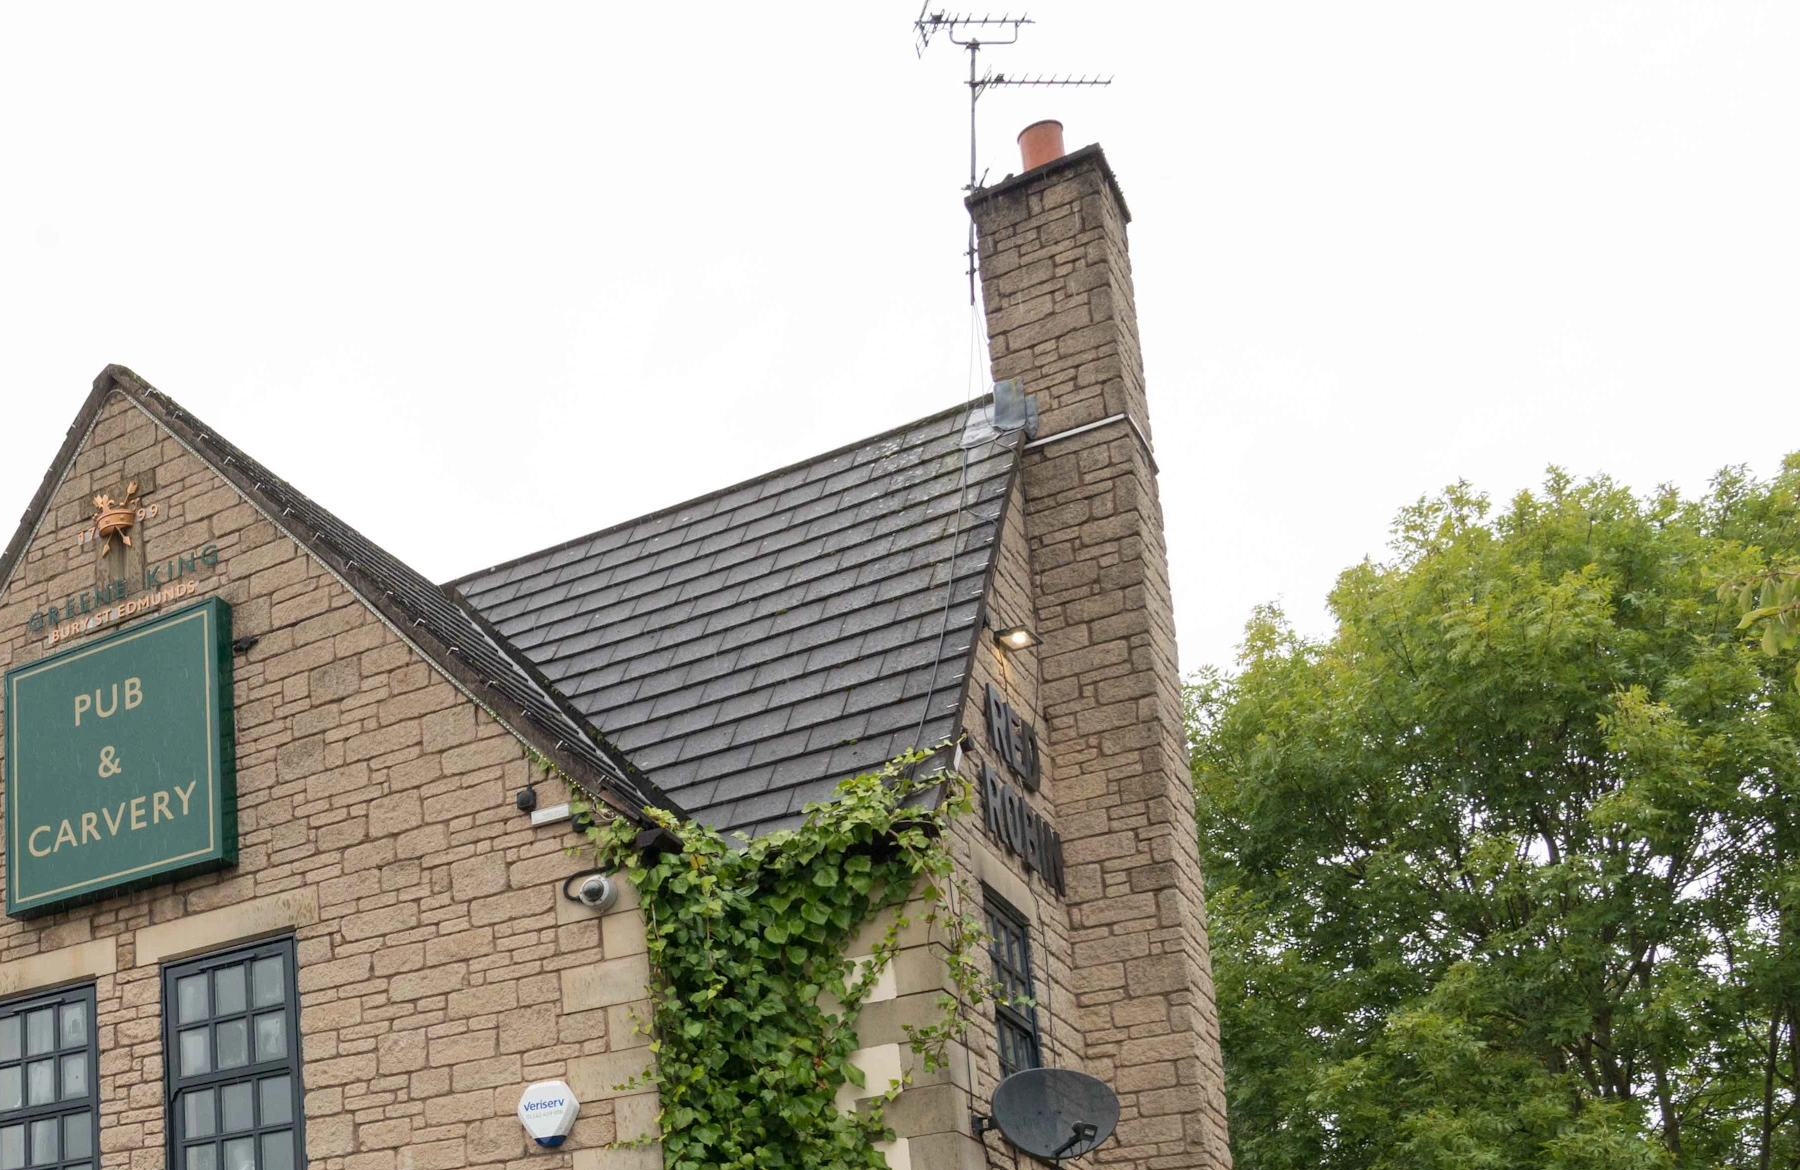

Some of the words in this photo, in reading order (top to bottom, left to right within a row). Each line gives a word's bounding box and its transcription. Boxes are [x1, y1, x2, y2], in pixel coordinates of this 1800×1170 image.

[28, 577, 128, 633] GREENE
[145, 544, 220, 590] KING
[51, 616, 90, 643] BURY
[93, 609, 112, 627] ST
[117, 579, 196, 618] EDMUNDS
[74, 676, 144, 727] PUB
[98, 745, 122, 779] &
[985, 682, 1042, 793] RED
[28, 780, 197, 858] CARVERY
[981, 759, 1067, 898] ROBIN
[523, 1098, 565, 1112] Veriserv
